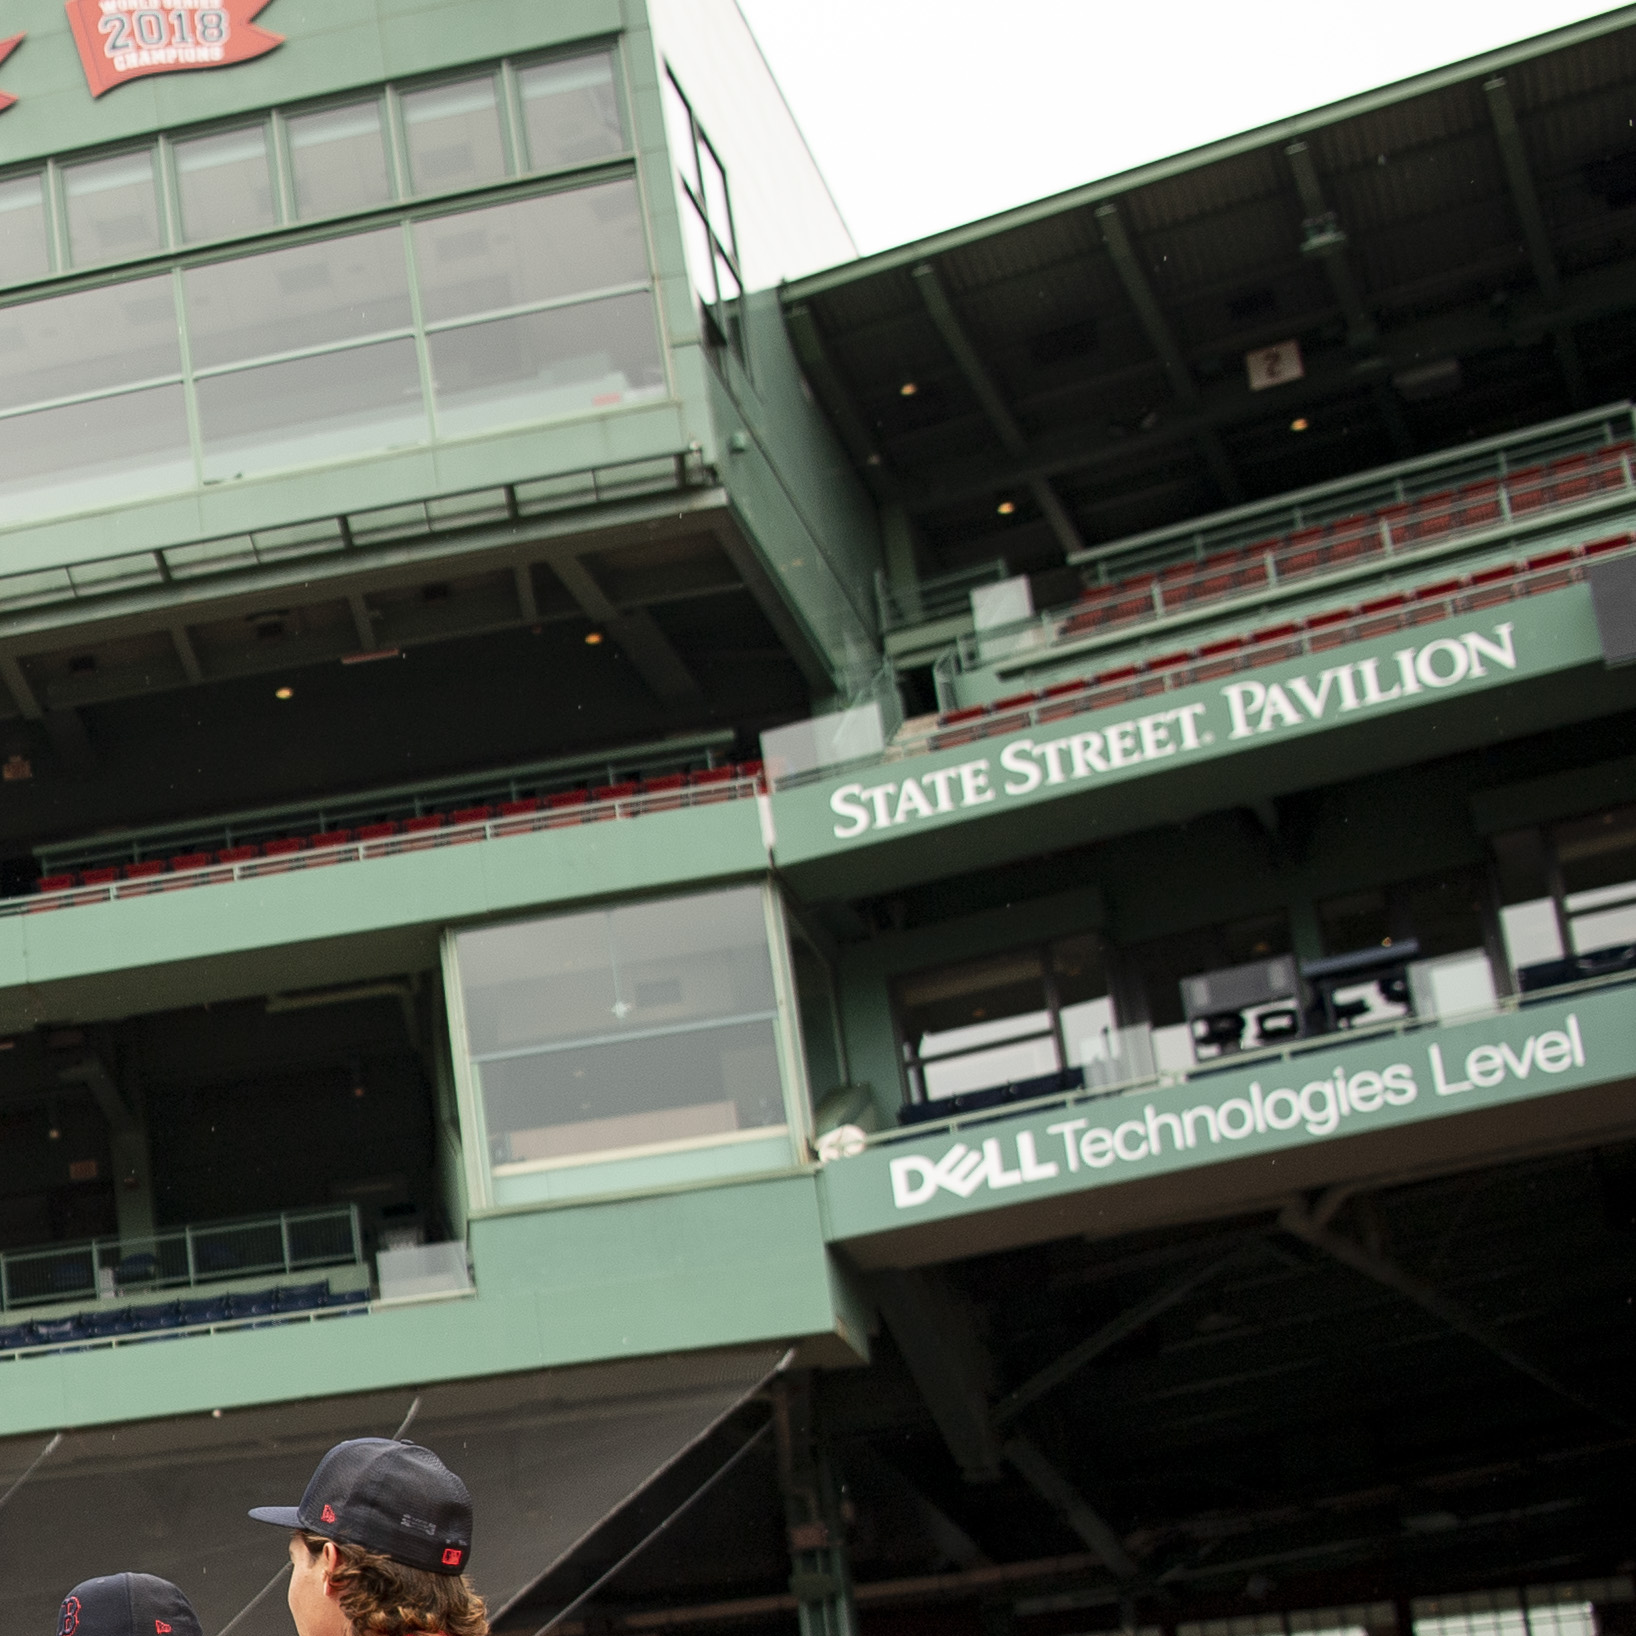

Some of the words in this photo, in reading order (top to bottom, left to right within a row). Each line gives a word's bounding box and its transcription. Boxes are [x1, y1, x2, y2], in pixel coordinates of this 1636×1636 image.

[97, 9, 230, 58] 2018
[114, 46, 224, 72] CHAMPIONS
[829, 757, 996, 838] STATE
[998, 703, 1205, 798] STREET
[1224, 622, 1518, 740] PAVILION
[888, 1130, 1058, 1209] DELL
[1049, 1063, 1416, 1170] Technologies
[1429, 1014, 1585, 1097] Level
